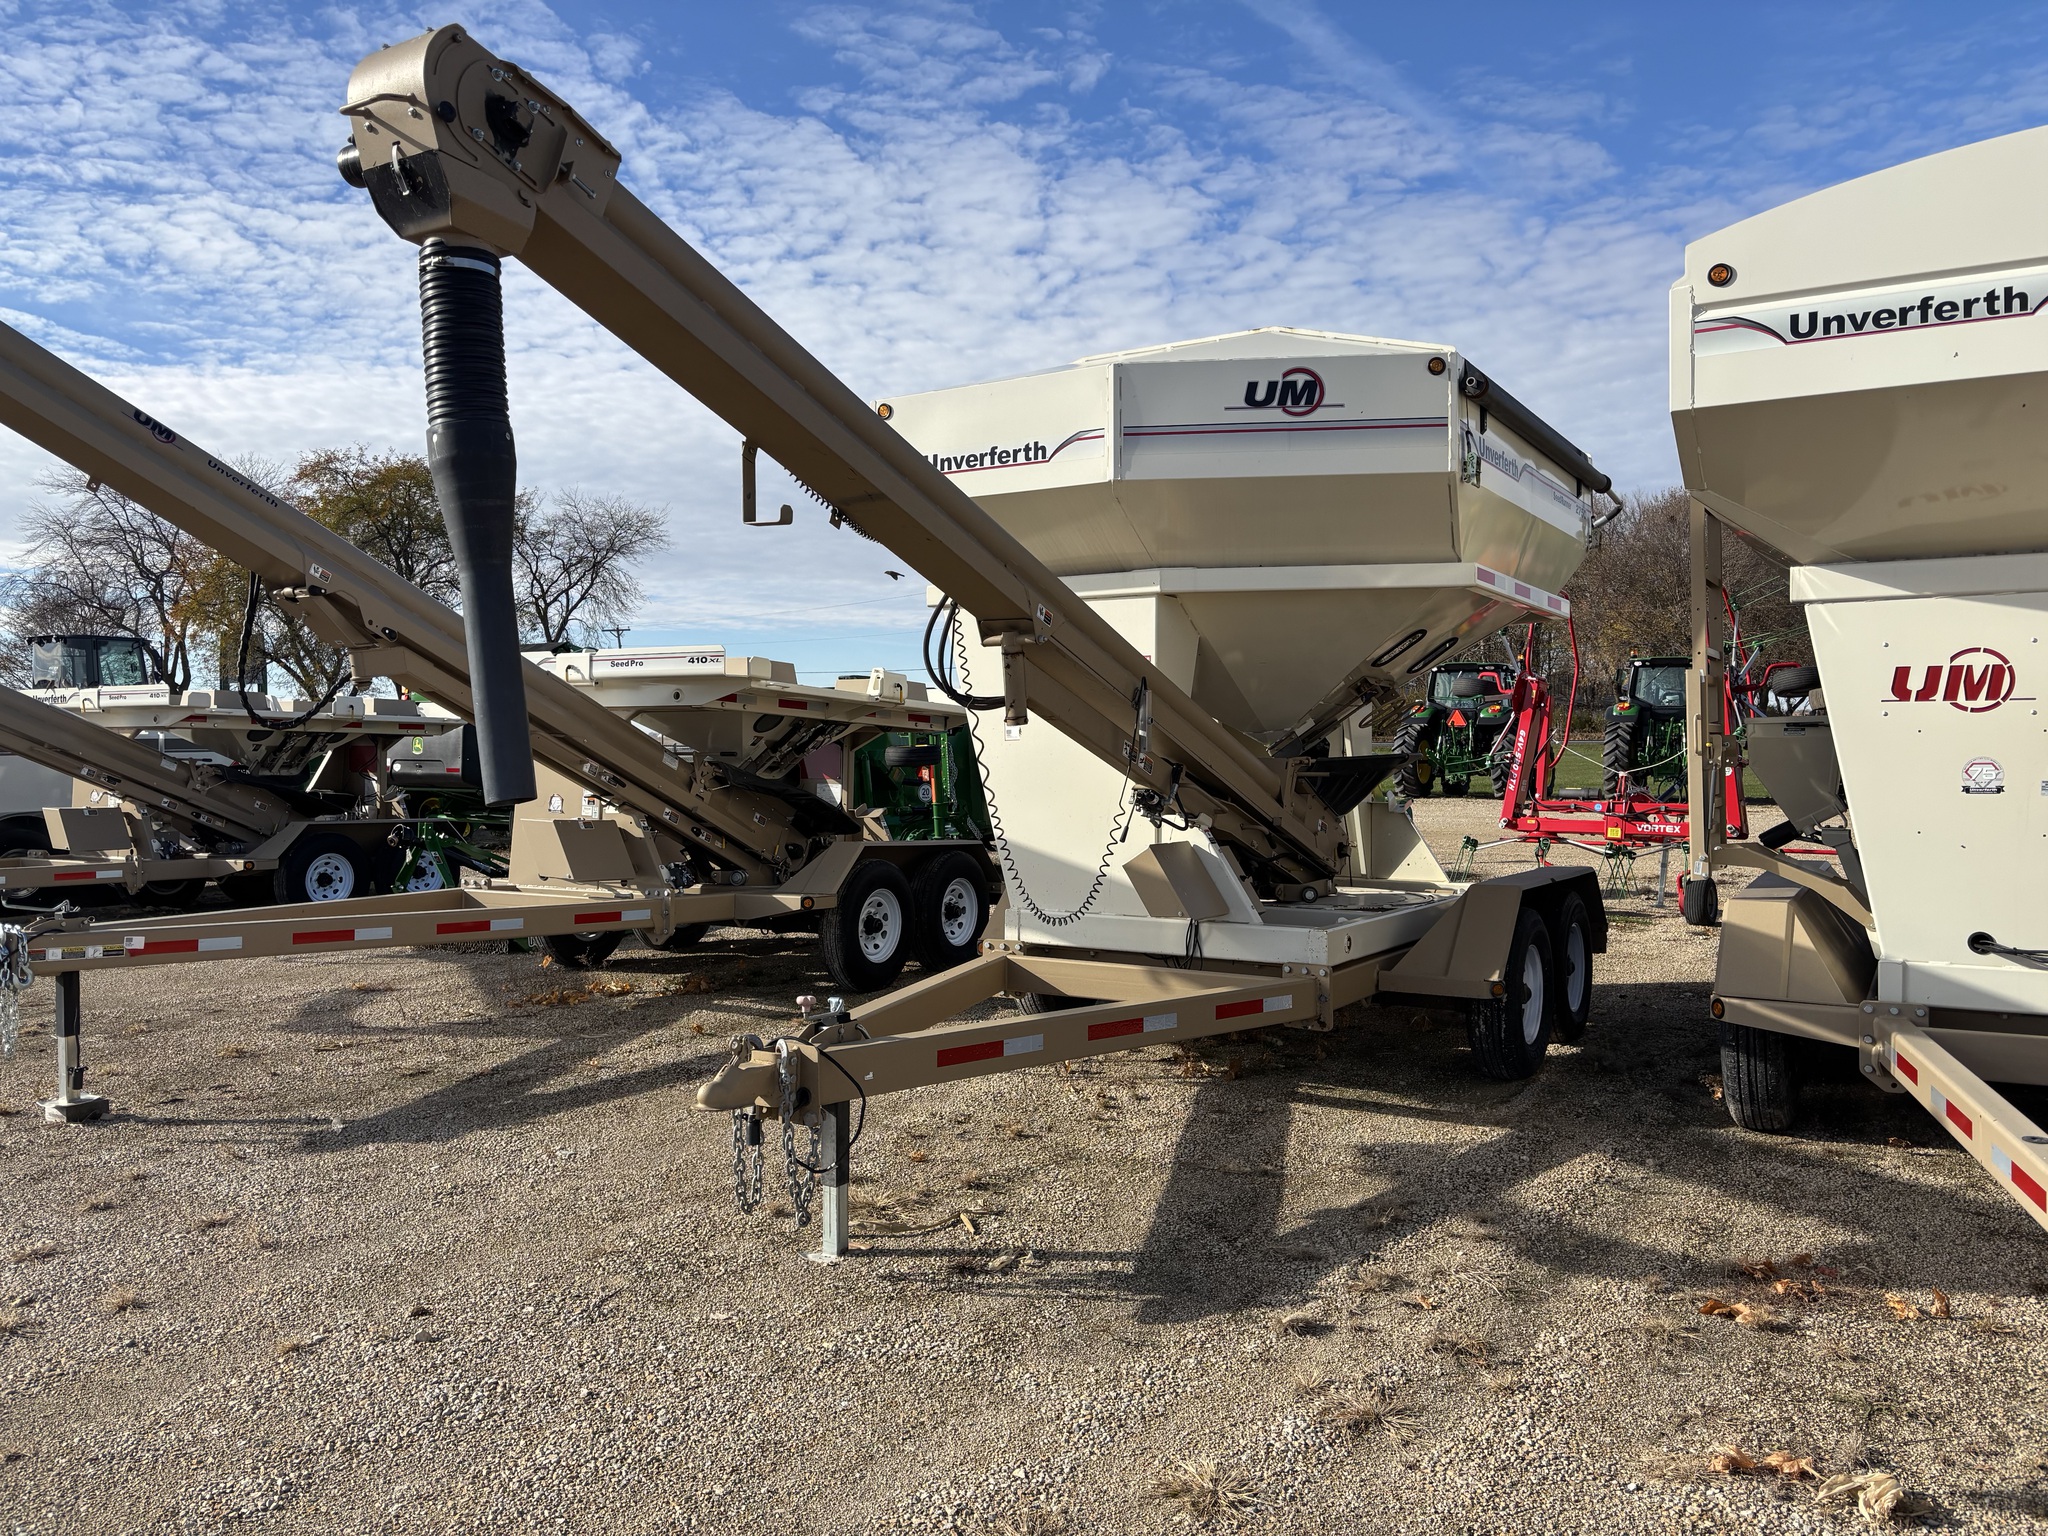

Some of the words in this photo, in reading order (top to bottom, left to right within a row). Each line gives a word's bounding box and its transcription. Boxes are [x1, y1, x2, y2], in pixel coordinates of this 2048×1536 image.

[1789, 285, 2030, 340] Unverferth
[1243, 376, 1320, 409] UM
[1478, 435, 1519, 479] Unverferth
[207, 459, 279, 508] Unverferth
[1890, 662, 2009, 704] UM
[1636, 823, 1681, 834] VORTEX
